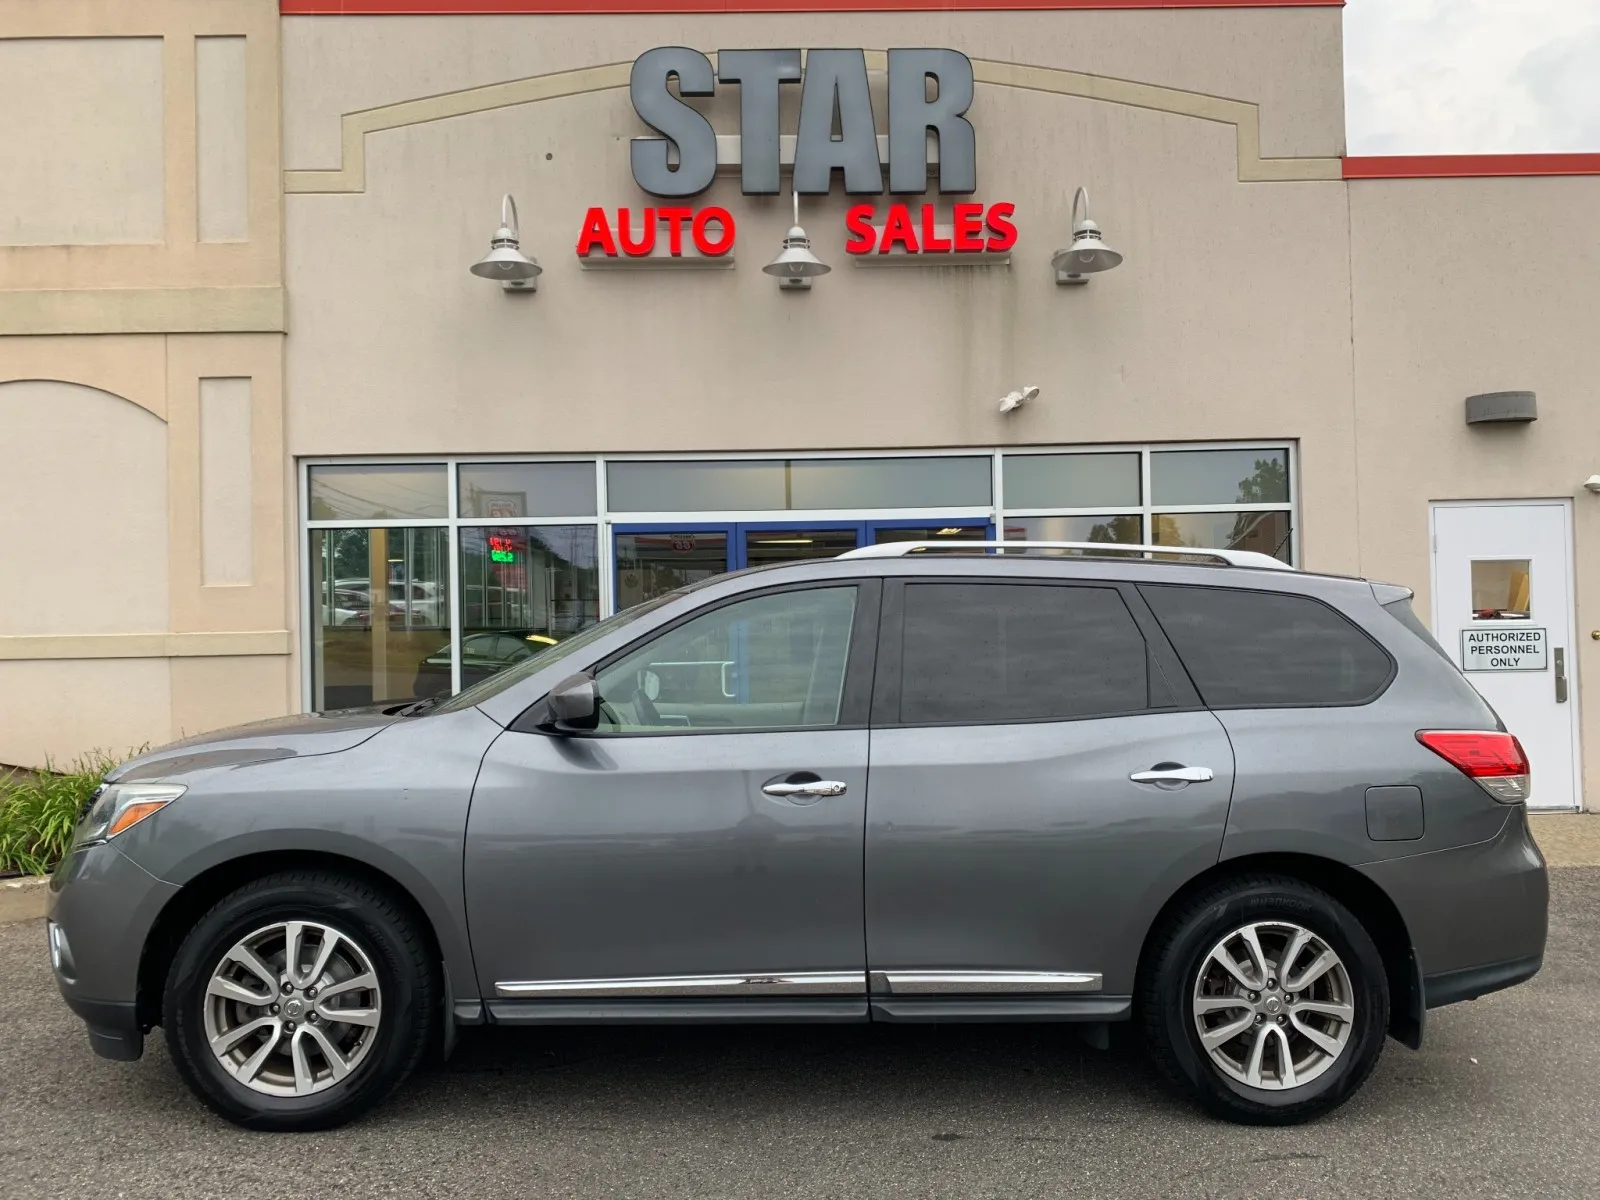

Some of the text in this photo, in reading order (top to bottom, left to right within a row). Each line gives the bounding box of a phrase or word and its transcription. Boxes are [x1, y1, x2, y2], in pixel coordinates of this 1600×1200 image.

[630, 46, 976, 198] STAR
[576, 202, 1018, 257] AUTO SALES
[1468, 632, 1541, 642] AUTHORIZED
[1470, 645, 1540, 655] PERSONNEL
[1490, 657, 1521, 667] ONLY
